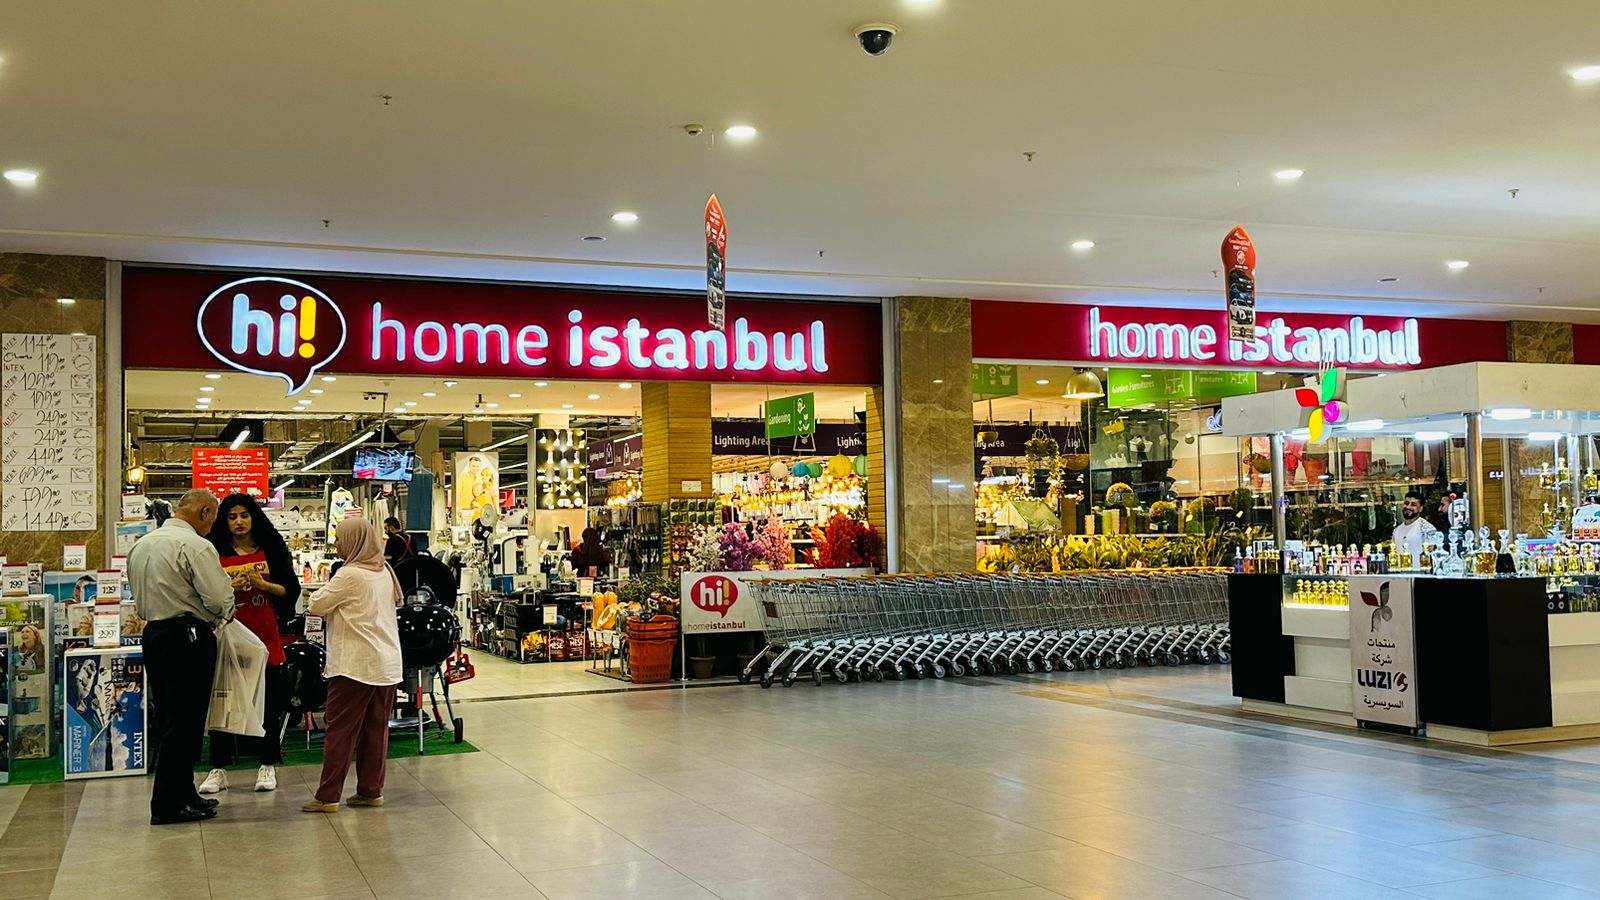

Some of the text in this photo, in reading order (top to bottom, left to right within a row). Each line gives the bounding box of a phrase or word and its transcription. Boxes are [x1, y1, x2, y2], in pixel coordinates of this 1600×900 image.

[232, 293, 316, 358] hi!
[1090, 307, 1217, 360] home
[372, 302, 829, 373] home istanbul
[768, 412, 791, 425] Gardening
[714, 435, 750, 447] Lighting
[700, 580, 730, 607] hi!
[1367, 638, 1396, 651] منتجات
[1371, 653, 1393, 667] شركة
[1363, 695, 1405, 711] السويسرية
[133, 731, 143, 767] INTEX
